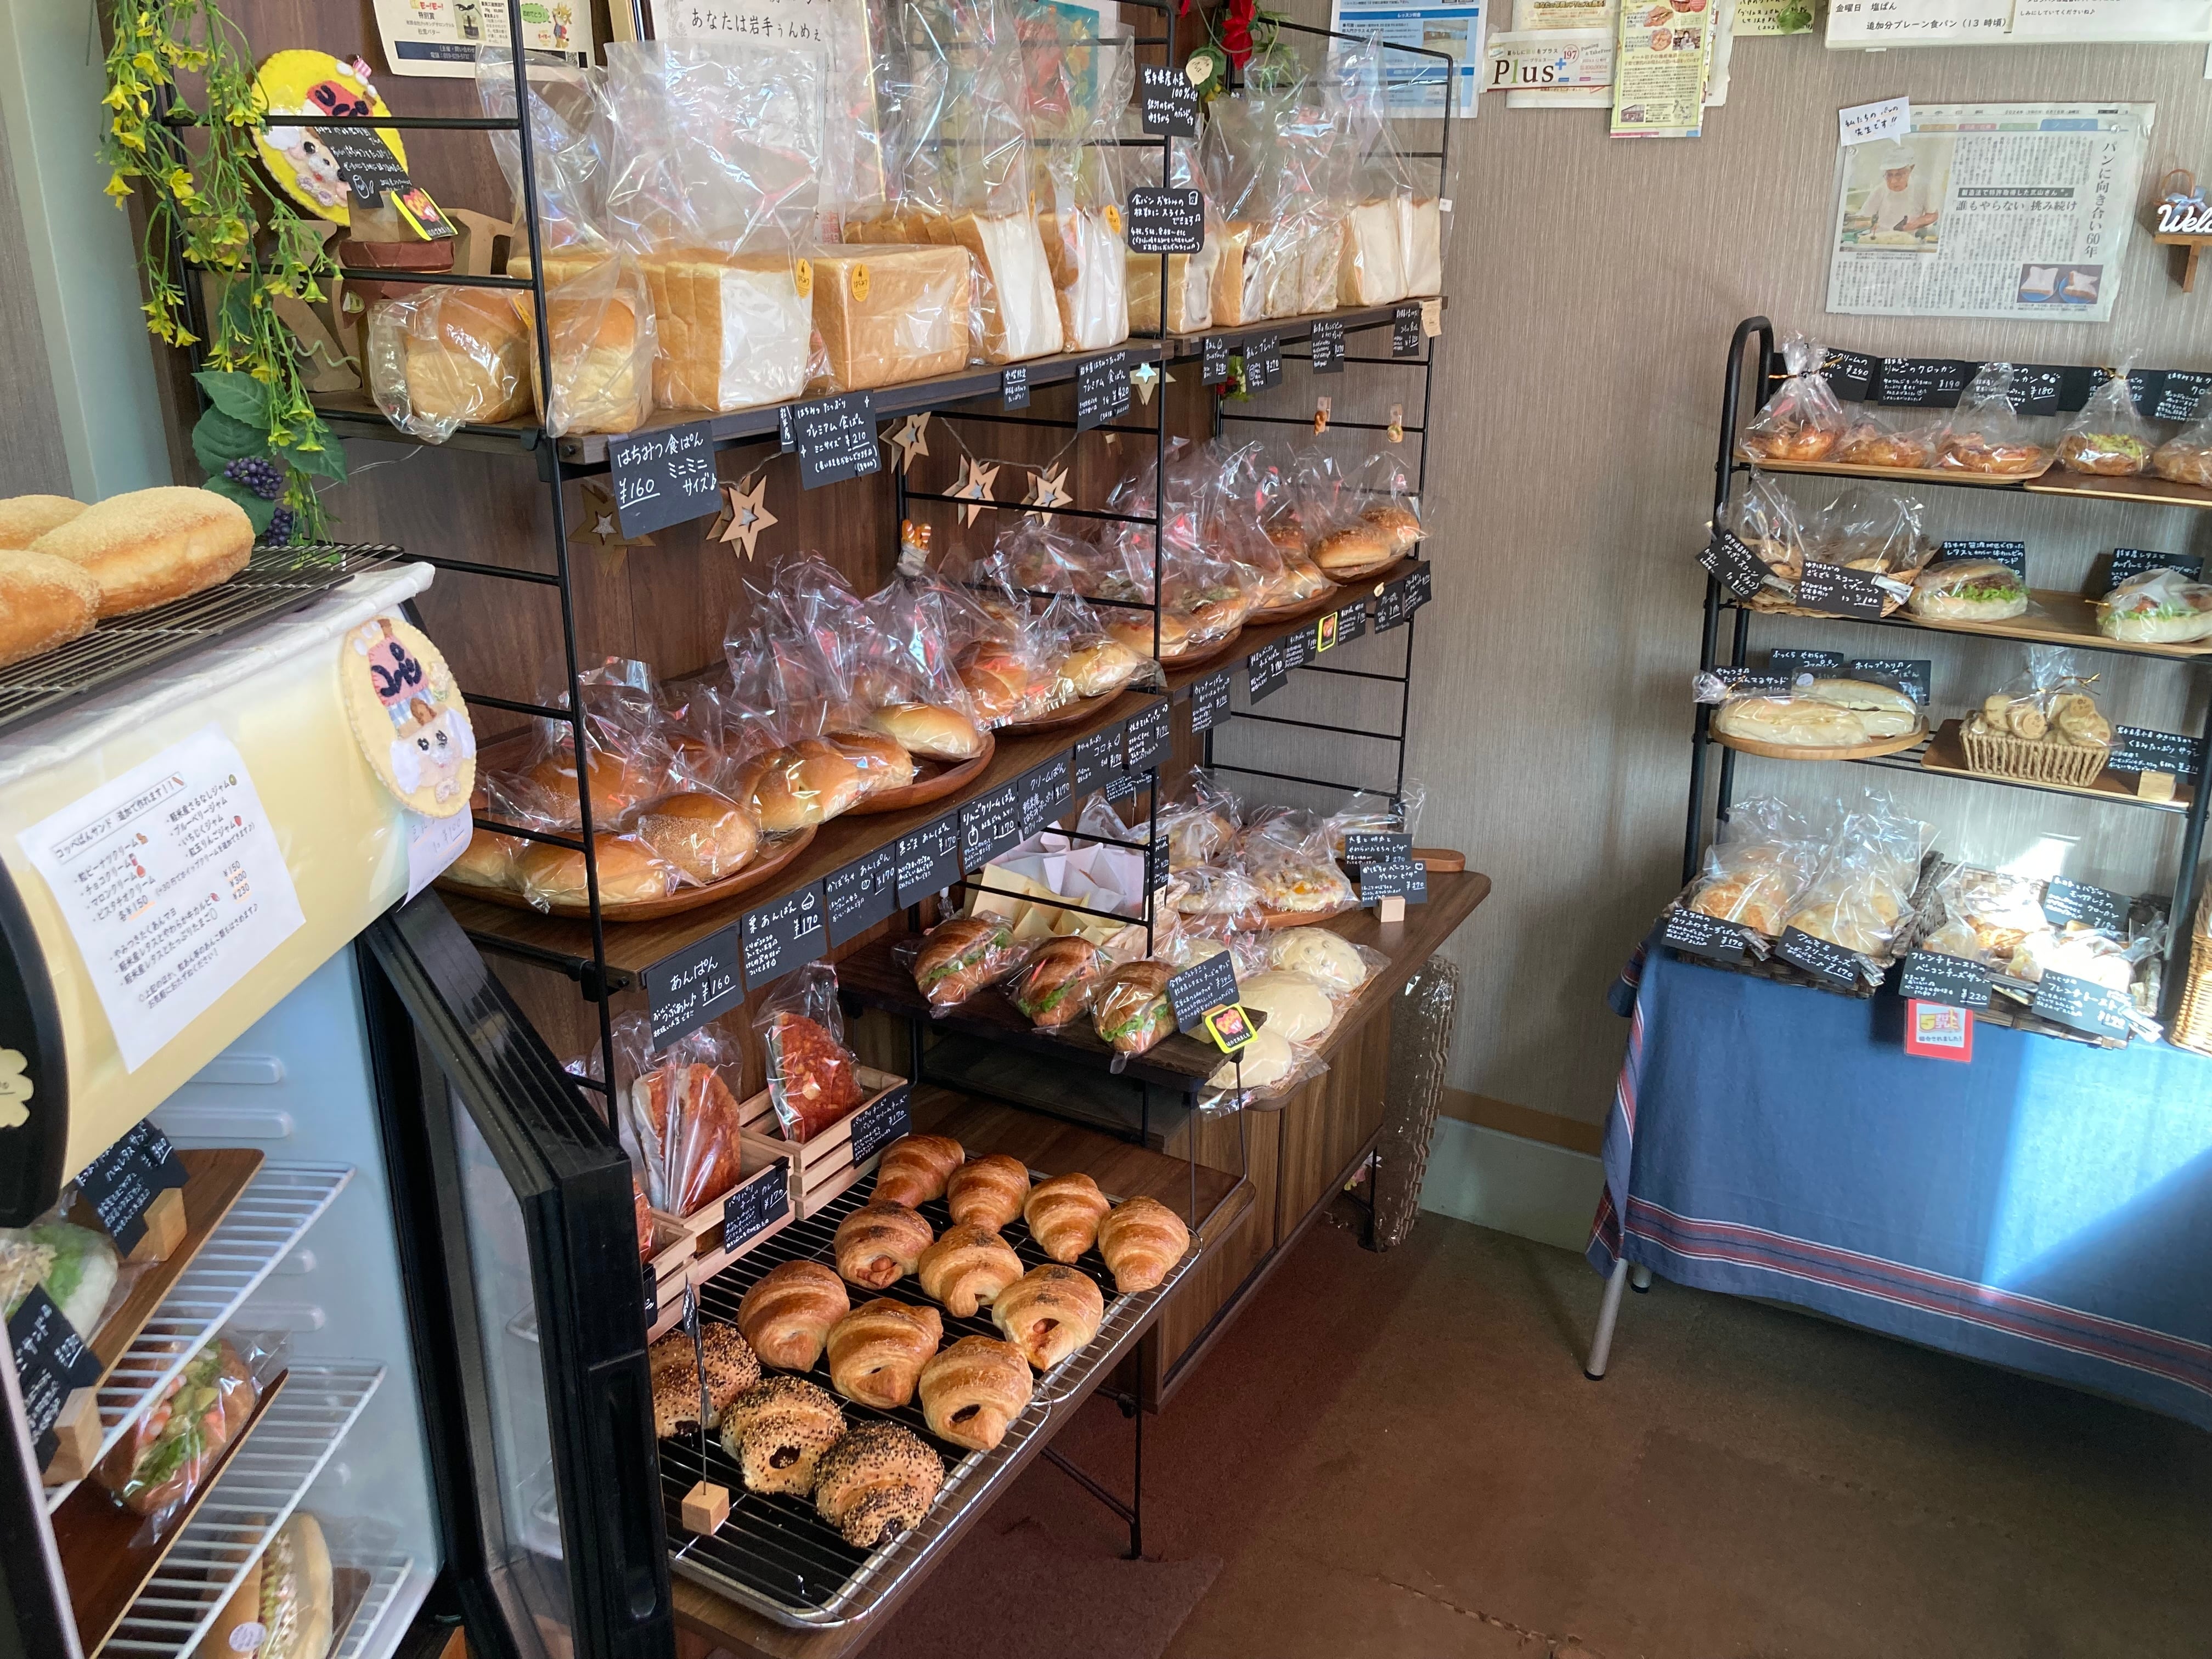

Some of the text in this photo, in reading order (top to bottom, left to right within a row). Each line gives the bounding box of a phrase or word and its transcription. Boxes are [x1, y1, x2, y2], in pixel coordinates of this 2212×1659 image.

[1836, 1, 1897, 12] 金曜日 塩ぱん
[1564, 50, 1577, 59] 197
[2085, 140, 2117, 258] パンに向き合い60年
[1938, 379, 1960, 388] ¥190
[2030, 385, 2054, 399] ¥180
[1112, 387, 1130, 402] ¥420
[806, 424, 838, 438] プレミアム
[815, 432, 866, 454] ミニサイズ ¥210
[668, 458, 708, 479] ミニミニ
[619, 477, 654, 504] ¥160
[1737, 560, 1759, 577] スコーン
[1835, 573, 1863, 584] スコーン
[1094, 740, 1112, 757] コロネ
[1030, 762, 1066, 791] クリームぱん
[1056, 783, 1070, 800] ¥170
[922, 822, 950, 844] あんぱん
[993, 820, 1014, 836] ¥170
[939, 836, 956, 853] ¥170
[1385, 855, 1406, 863] ¥270
[223, 860, 241, 878] ¥150
[827, 853, 890, 893] かぼちゃ あんぱん
[877, 867, 895, 888] ¥170
[229, 870, 247, 888] ¥300
[1406, 881, 1425, 891] ¥270
[233, 882, 251, 901] ¥230
[793, 914, 818, 936] ¥170
[1721, 936, 1743, 947] ¥170
[1911, 952, 1986, 973] フレンチトーストの
[670, 956, 718, 991] あんぱん
[1215, 974, 1232, 990] ¥340
[702, 974, 730, 1002] ¥160
[1961, 988, 1988, 1001] ¥220
[662, 999, 690, 1022] つぶあん
[888, 1109, 905, 1126] ¥170
